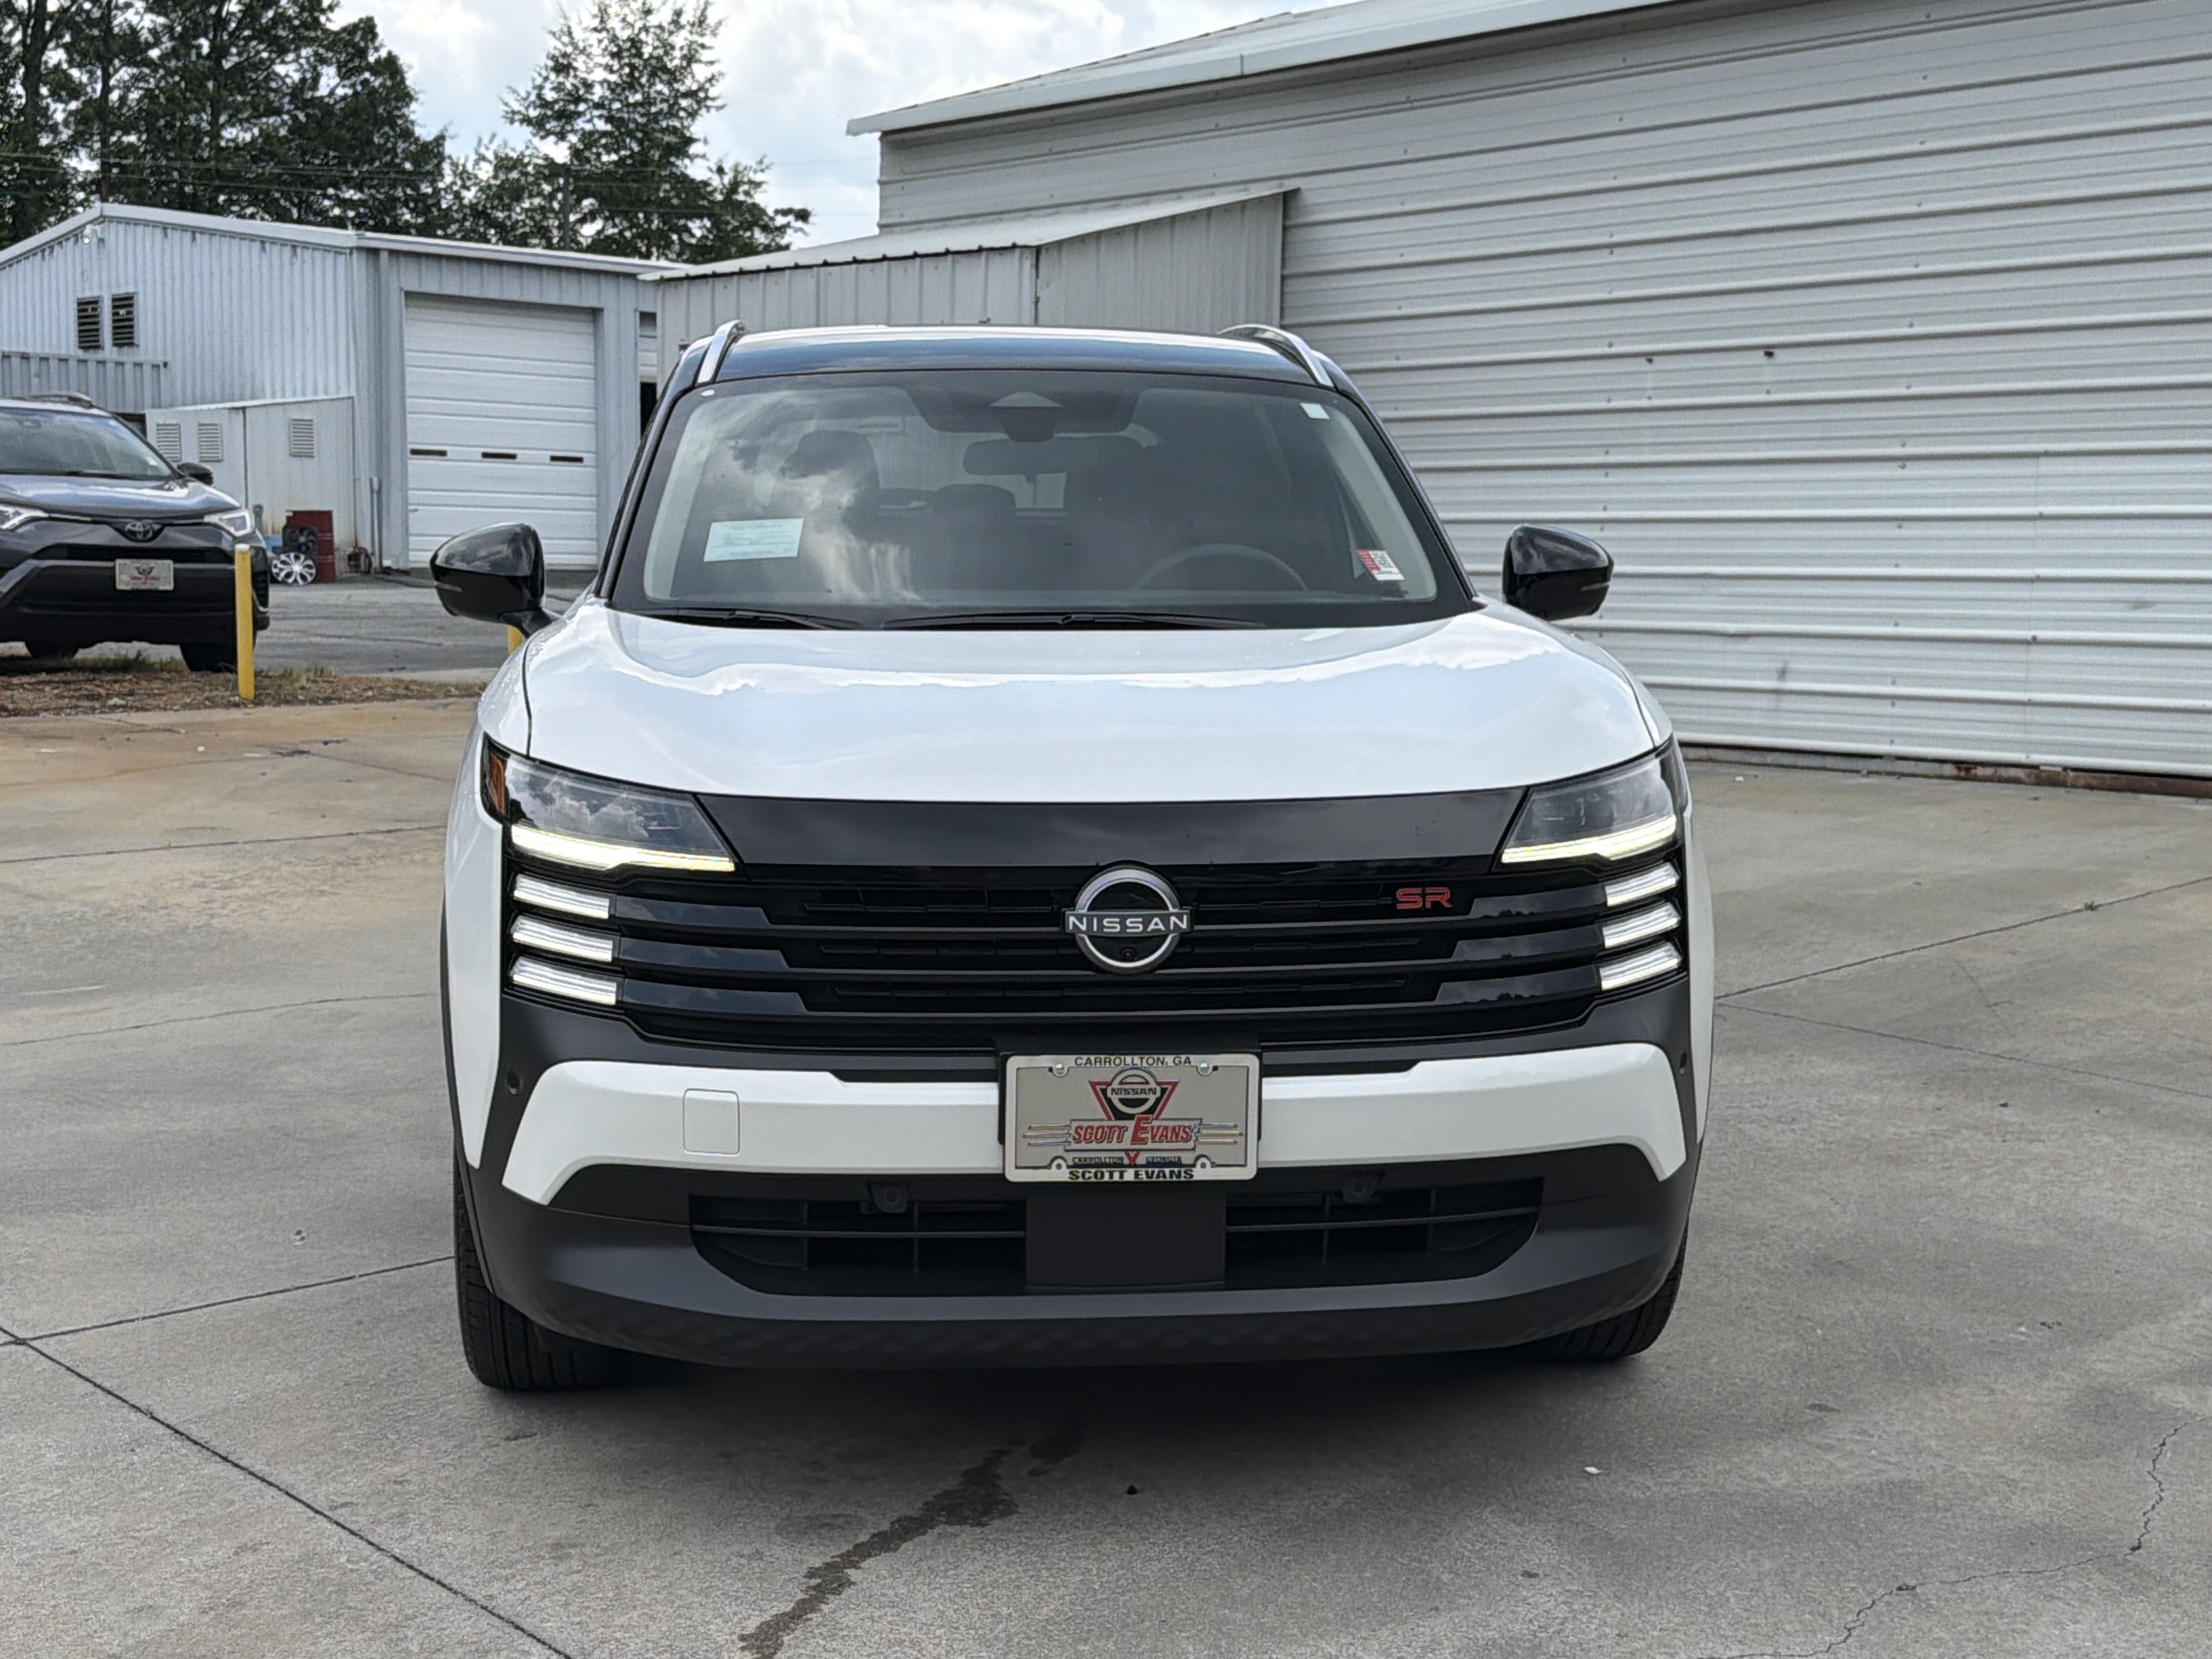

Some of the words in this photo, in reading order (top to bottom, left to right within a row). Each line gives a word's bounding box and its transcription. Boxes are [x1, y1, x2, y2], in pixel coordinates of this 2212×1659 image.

[1396, 887, 1452, 909] SR
[1069, 915, 1187, 932] NISSAN
[1172, 1056, 1192, 1065] GA
[1110, 1087, 1157, 1096] NISSAN
[1073, 1125, 1129, 1144] SCOTT
[1131, 1115, 1193, 1144] EVANS
[1068, 1170, 1127, 1180] SCOTT
[1134, 1169, 1194, 1180] EVANS
